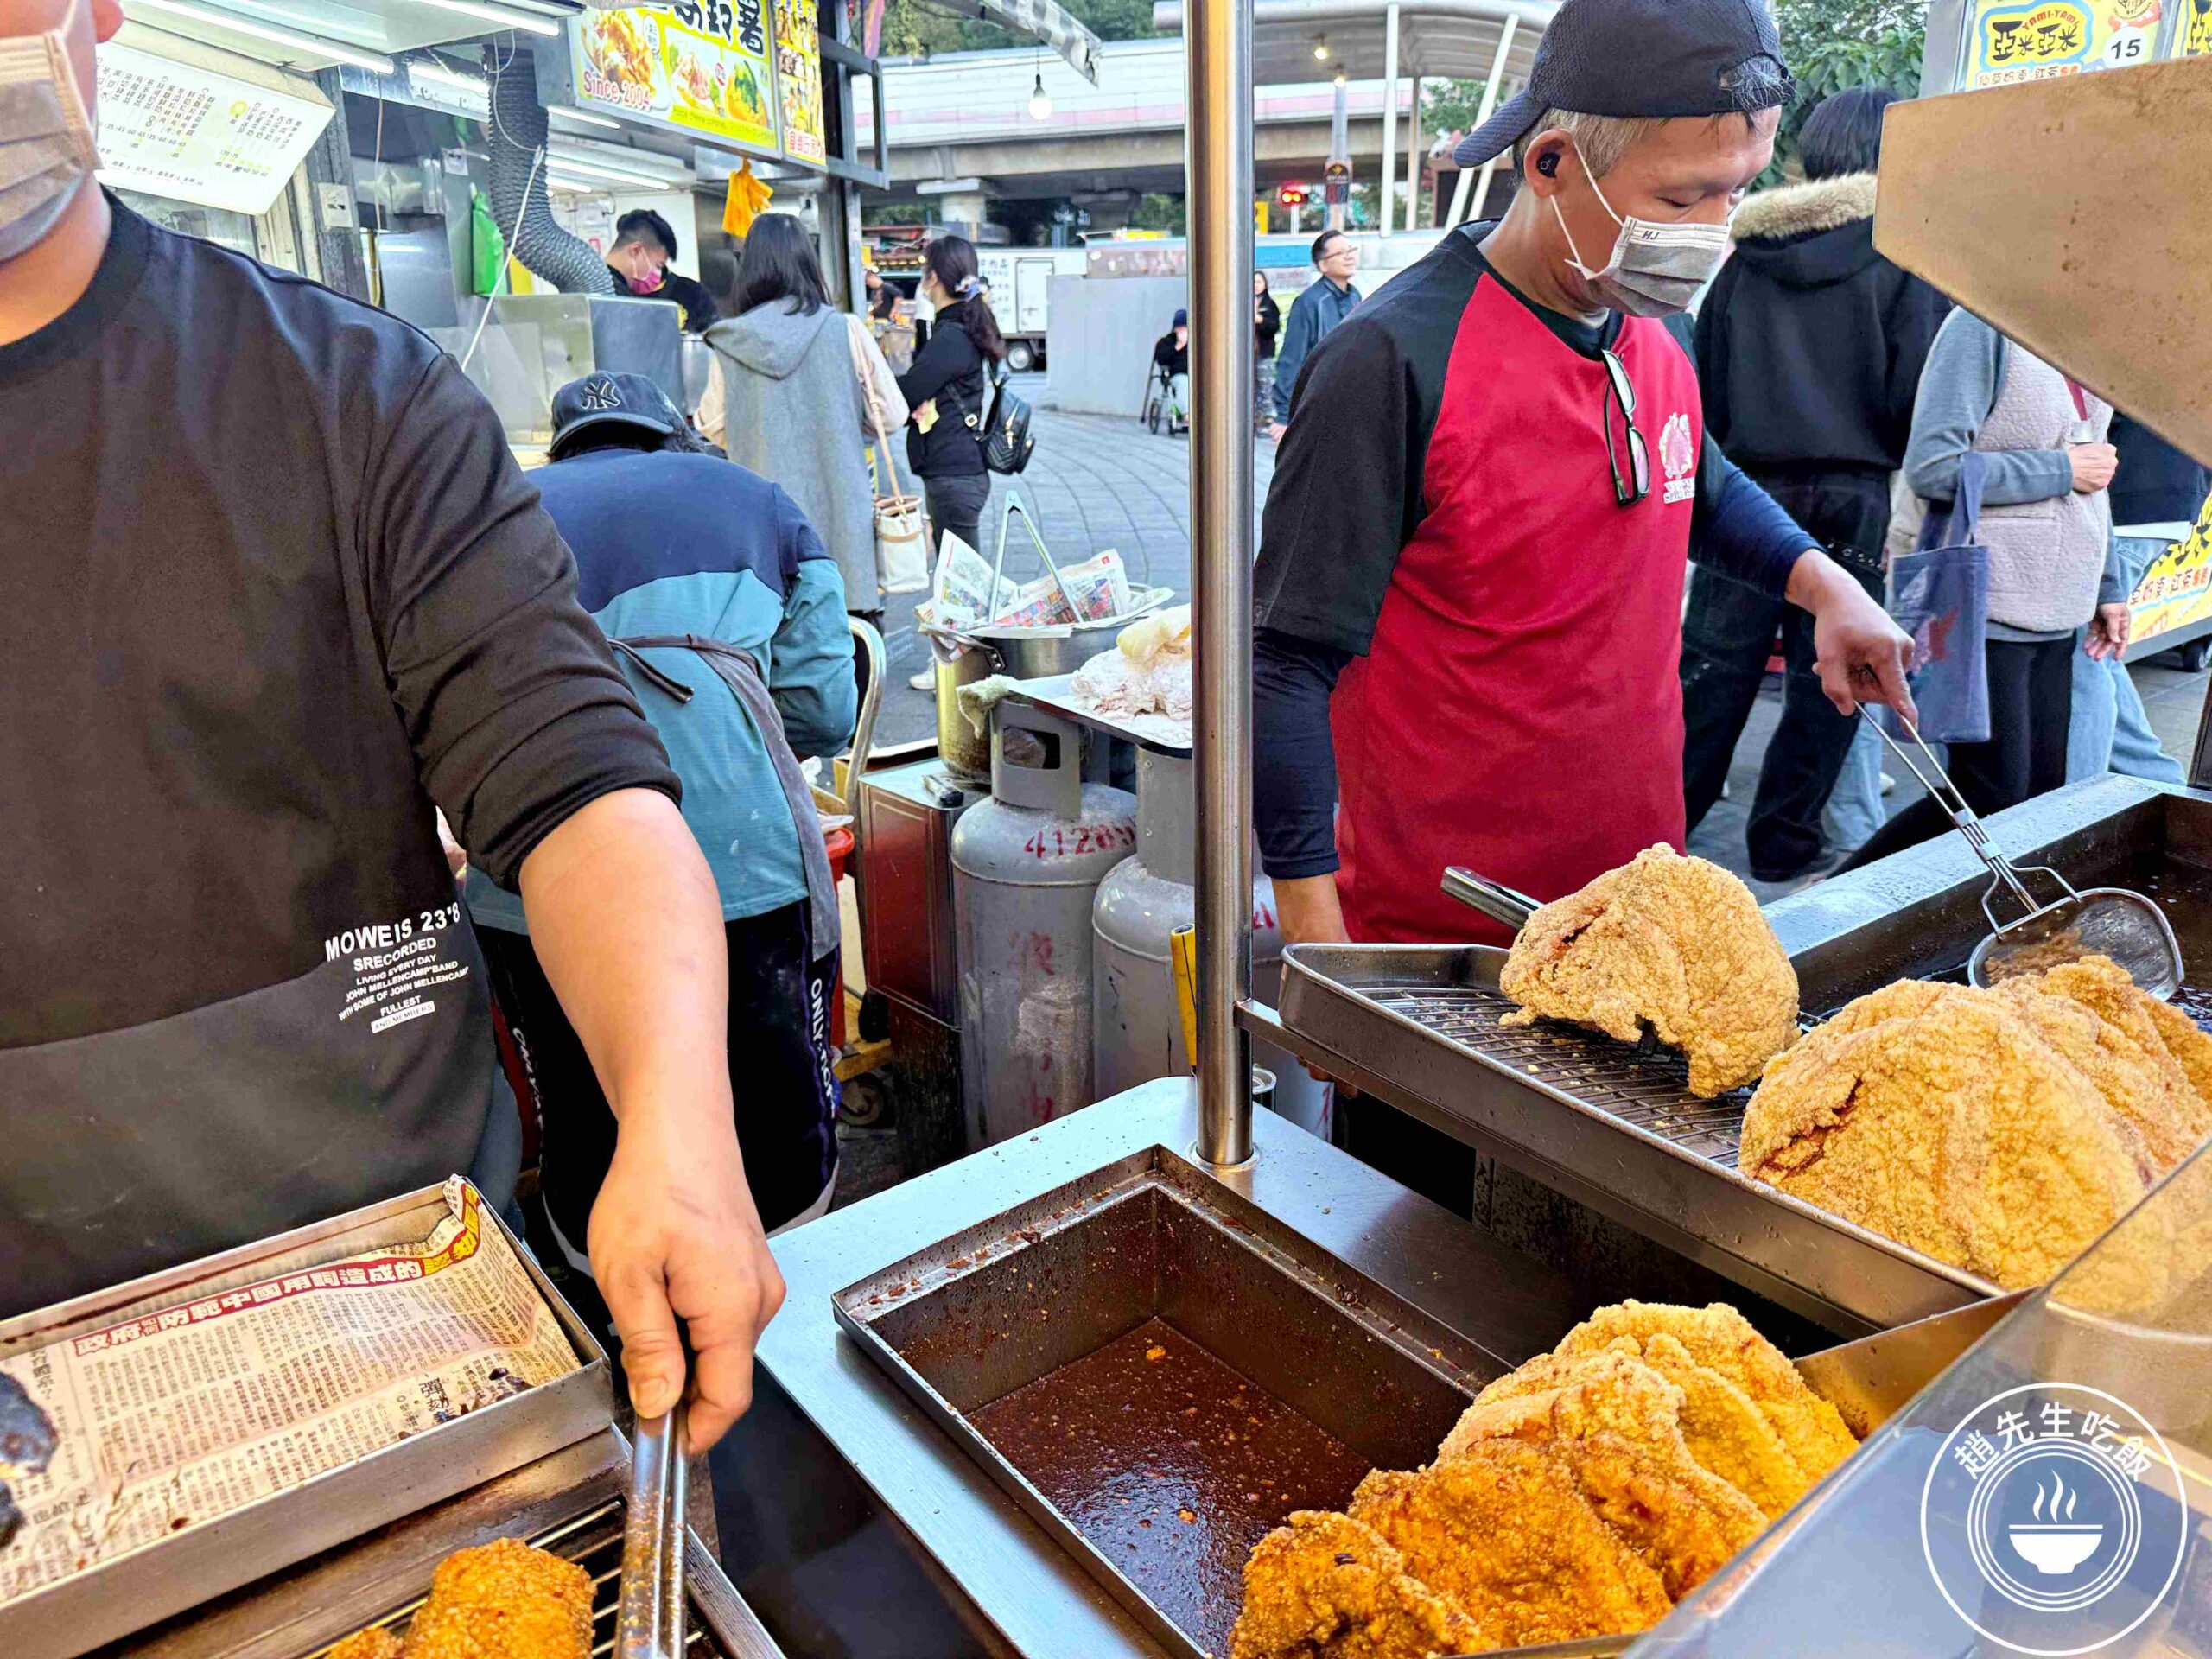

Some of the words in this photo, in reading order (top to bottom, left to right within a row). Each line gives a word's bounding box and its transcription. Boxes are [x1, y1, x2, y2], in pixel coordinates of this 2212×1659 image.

[2022, 10, 2080, 30] YAMI-YAMI
[1992, 21, 2079, 60] 亞米亞米
[2111, 39, 2140, 59] 15
[583, 71, 620, 103] Since
[622, 79, 652, 111] 2004
[1642, 231, 1660, 240] HJ
[353, 937, 437, 972] SRECORDED
[356, 970, 387, 986] LIVING
[388, 959, 416, 977] EVERY
[417, 954, 437, 965] DAY
[338, 1007, 354, 1021] WITH
[353, 997, 377, 1015] SOME
[376, 991, 389, 1001] OF
[390, 983, 413, 998] JOHN
[414, 966, 470, 988] MELLENCAMP
[346, 987, 367, 1003] JOHN
[380, 995, 422, 1017] FULLEST
[374, 1020, 391, 1030] AND
[392, 1004, 434, 1023] MEMBERS
